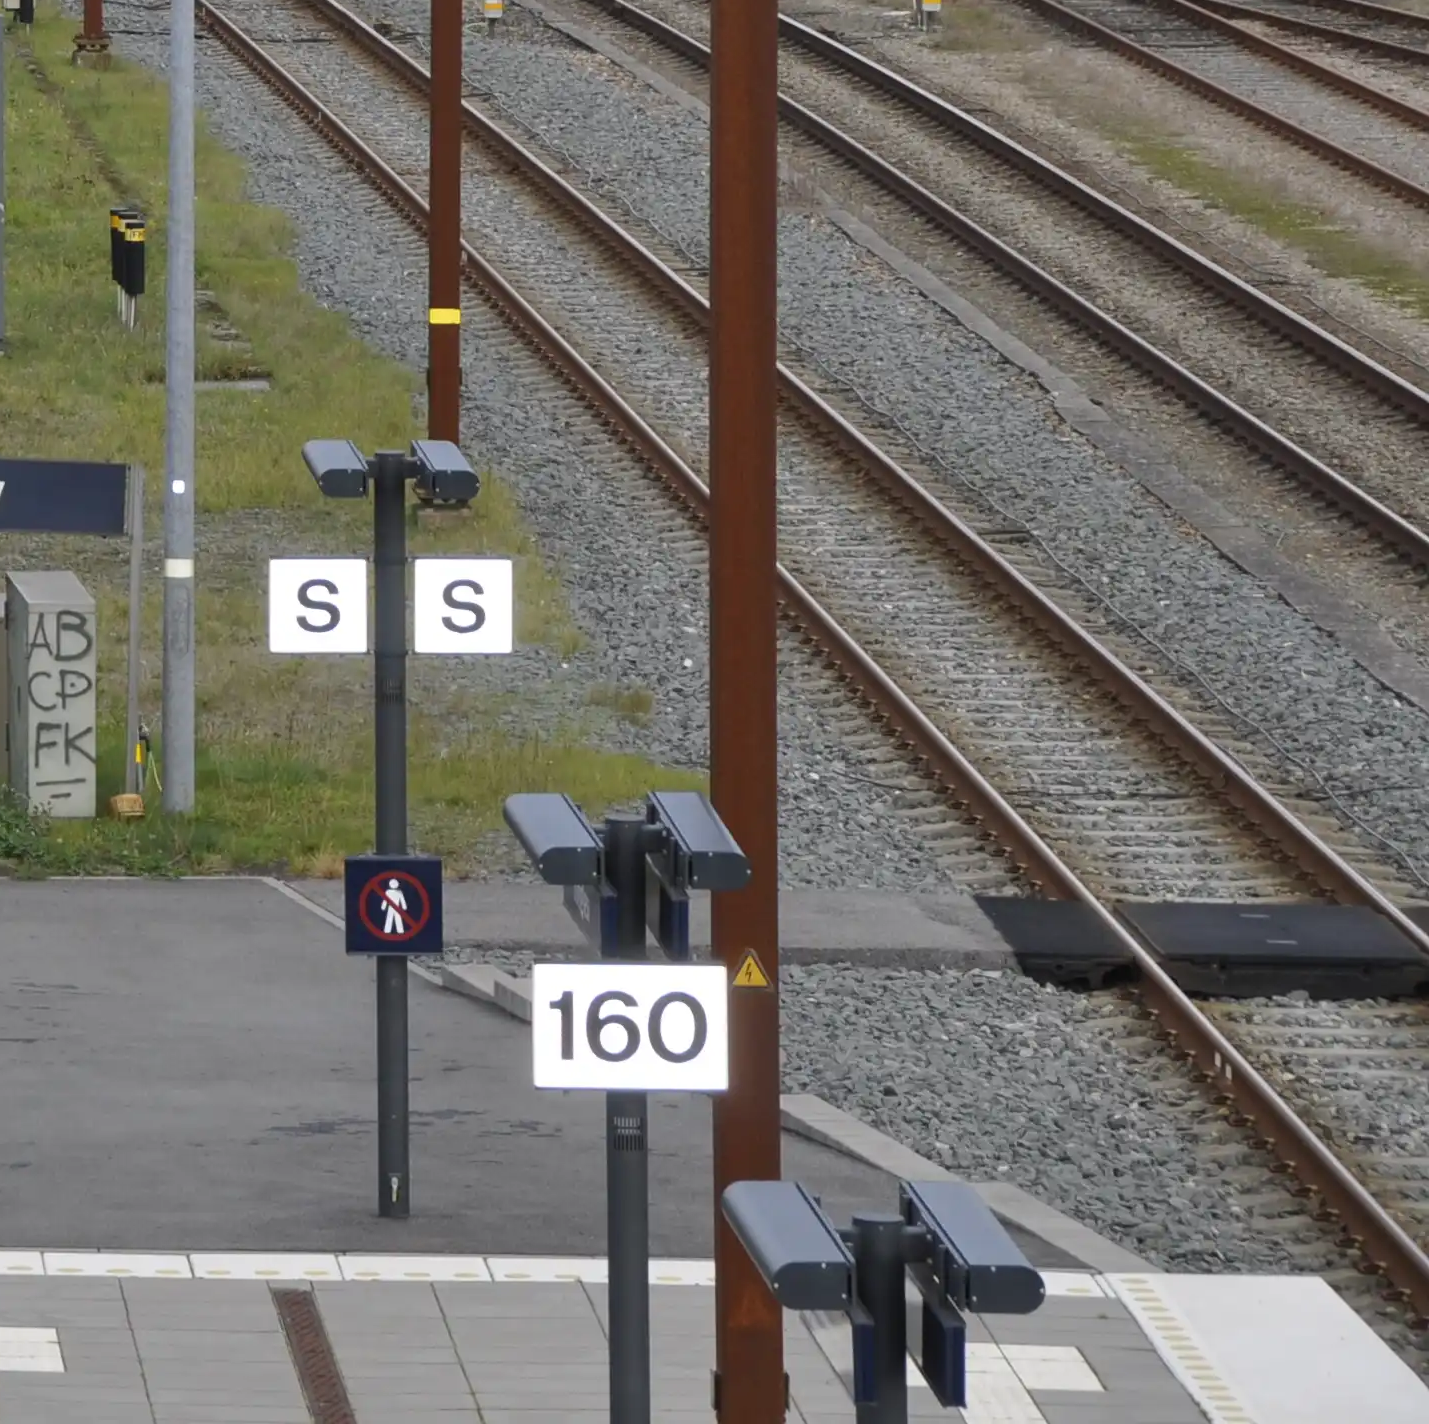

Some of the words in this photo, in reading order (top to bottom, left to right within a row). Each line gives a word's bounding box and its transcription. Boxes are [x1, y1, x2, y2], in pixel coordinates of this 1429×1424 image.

[296, 578, 341, 634] S
[441, 579, 487, 634] S
[26, 609, 94, 662] AB
[27, 669, 94, 712] CP
[35, 721, 97, 769] FK
[548, 989, 709, 1064] 160
